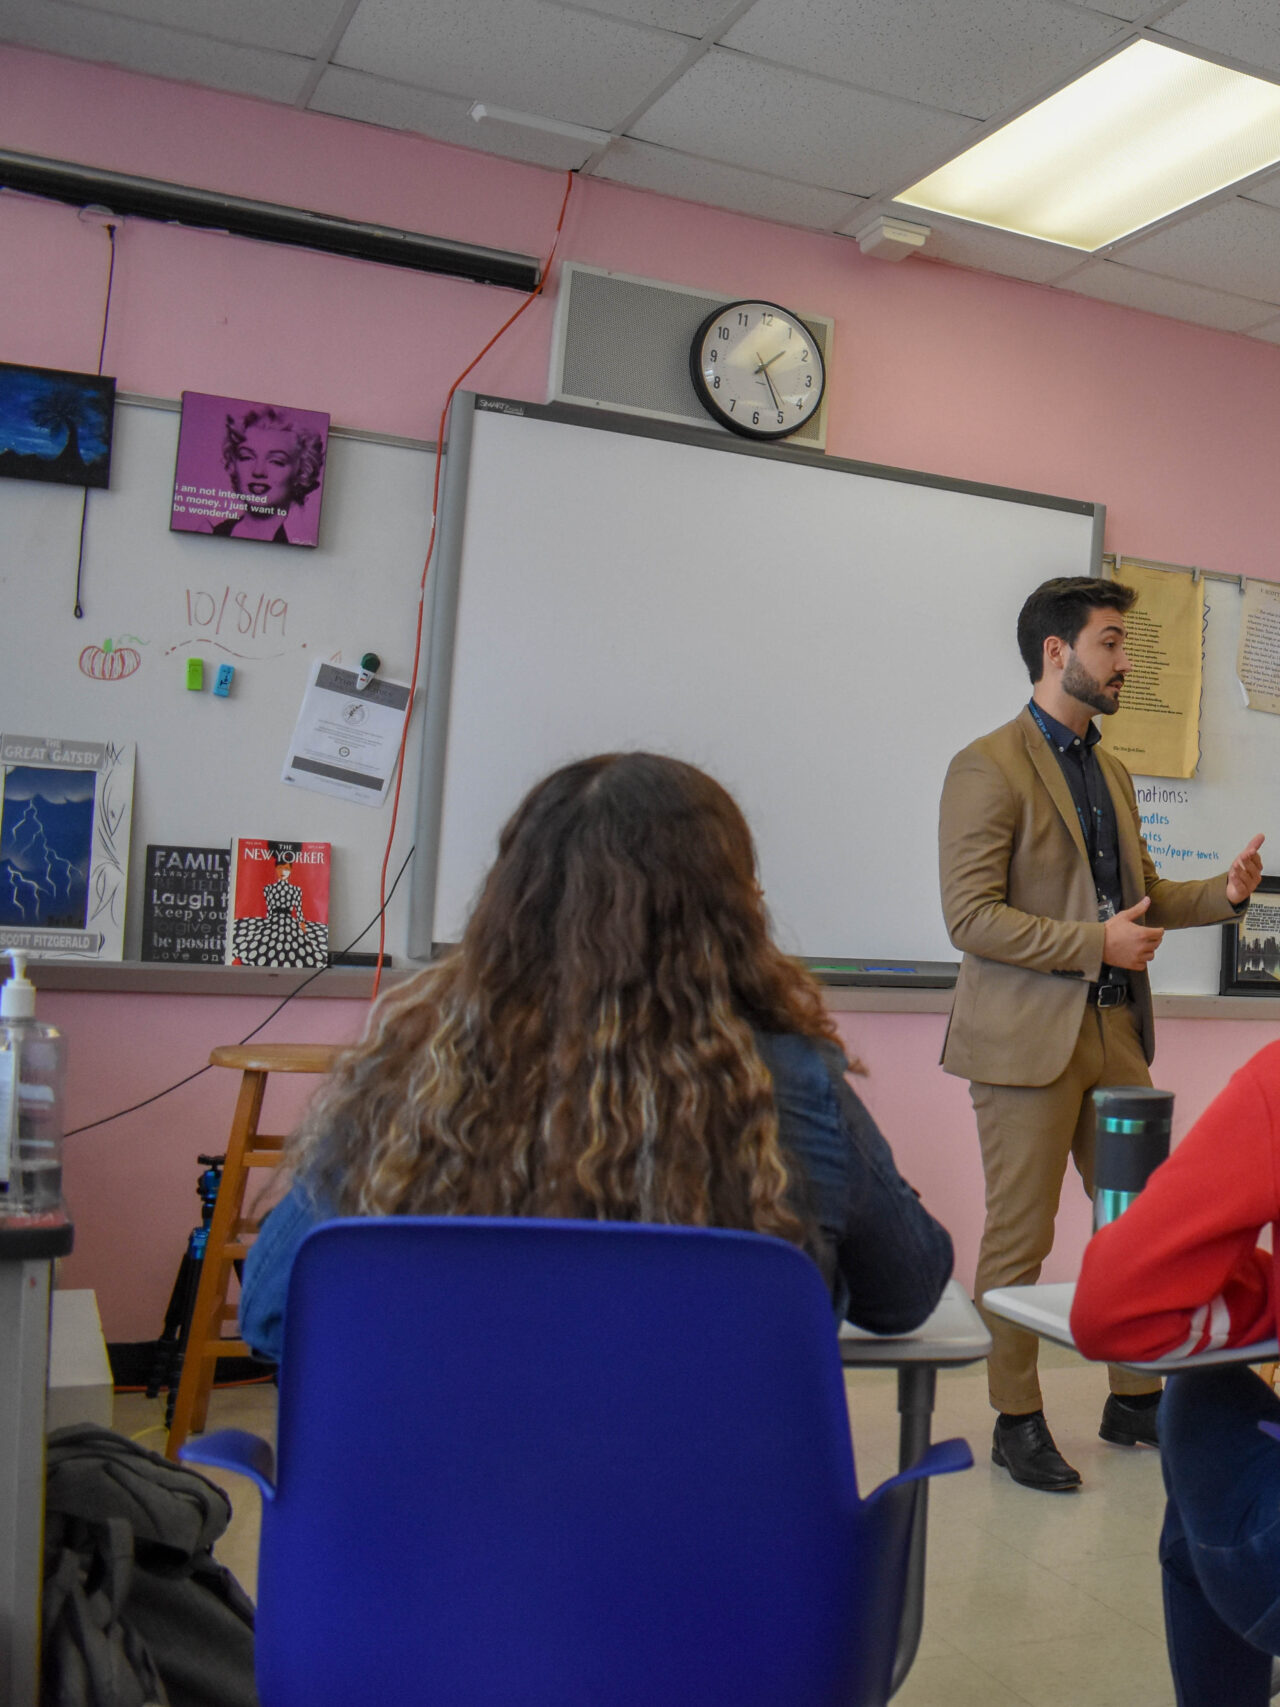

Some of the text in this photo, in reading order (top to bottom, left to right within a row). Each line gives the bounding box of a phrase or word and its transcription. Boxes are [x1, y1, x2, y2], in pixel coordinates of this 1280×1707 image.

[738, 312, 749, 327] 11
[761, 312, 774, 327] 12
[717, 326, 730, 341] 10
[787, 327, 793, 339] 1
[710, 350, 718, 363] 9
[801, 350, 809, 362] 2
[713, 376, 721, 389] 8
[804, 375, 813, 388] 3
[729, 399, 737, 412] 7
[795, 398, 803, 410] 4
[752, 411, 760, 425] 6
[777, 411, 784, 424] 5
[181, 484, 197, 493] am
[199, 487, 216, 497] not
[218, 490, 268, 504] interested
[173, 504, 241, 521] be wonderful.
[174, 494, 184, 502] in
[186, 496, 221, 509] money.
[229, 502, 248, 512] just
[250, 505, 275, 515] want
[277, 508, 288, 517] to
[186, 586, 288, 639] 10/8/19
[45, 738, 62, 749] THE
[4, 745, 101, 765] GREAT GATSBY
[1137, 785, 1188, 804] nations:
[244, 848, 325, 864] NEW YORKER
[154, 869, 197, 879] Always
[152, 889, 215, 910] Laugh
[153, 906, 194, 920] Keep
[0, 931, 91, 949] SCOTT FITZGERALD
[153, 931, 171, 948] be
